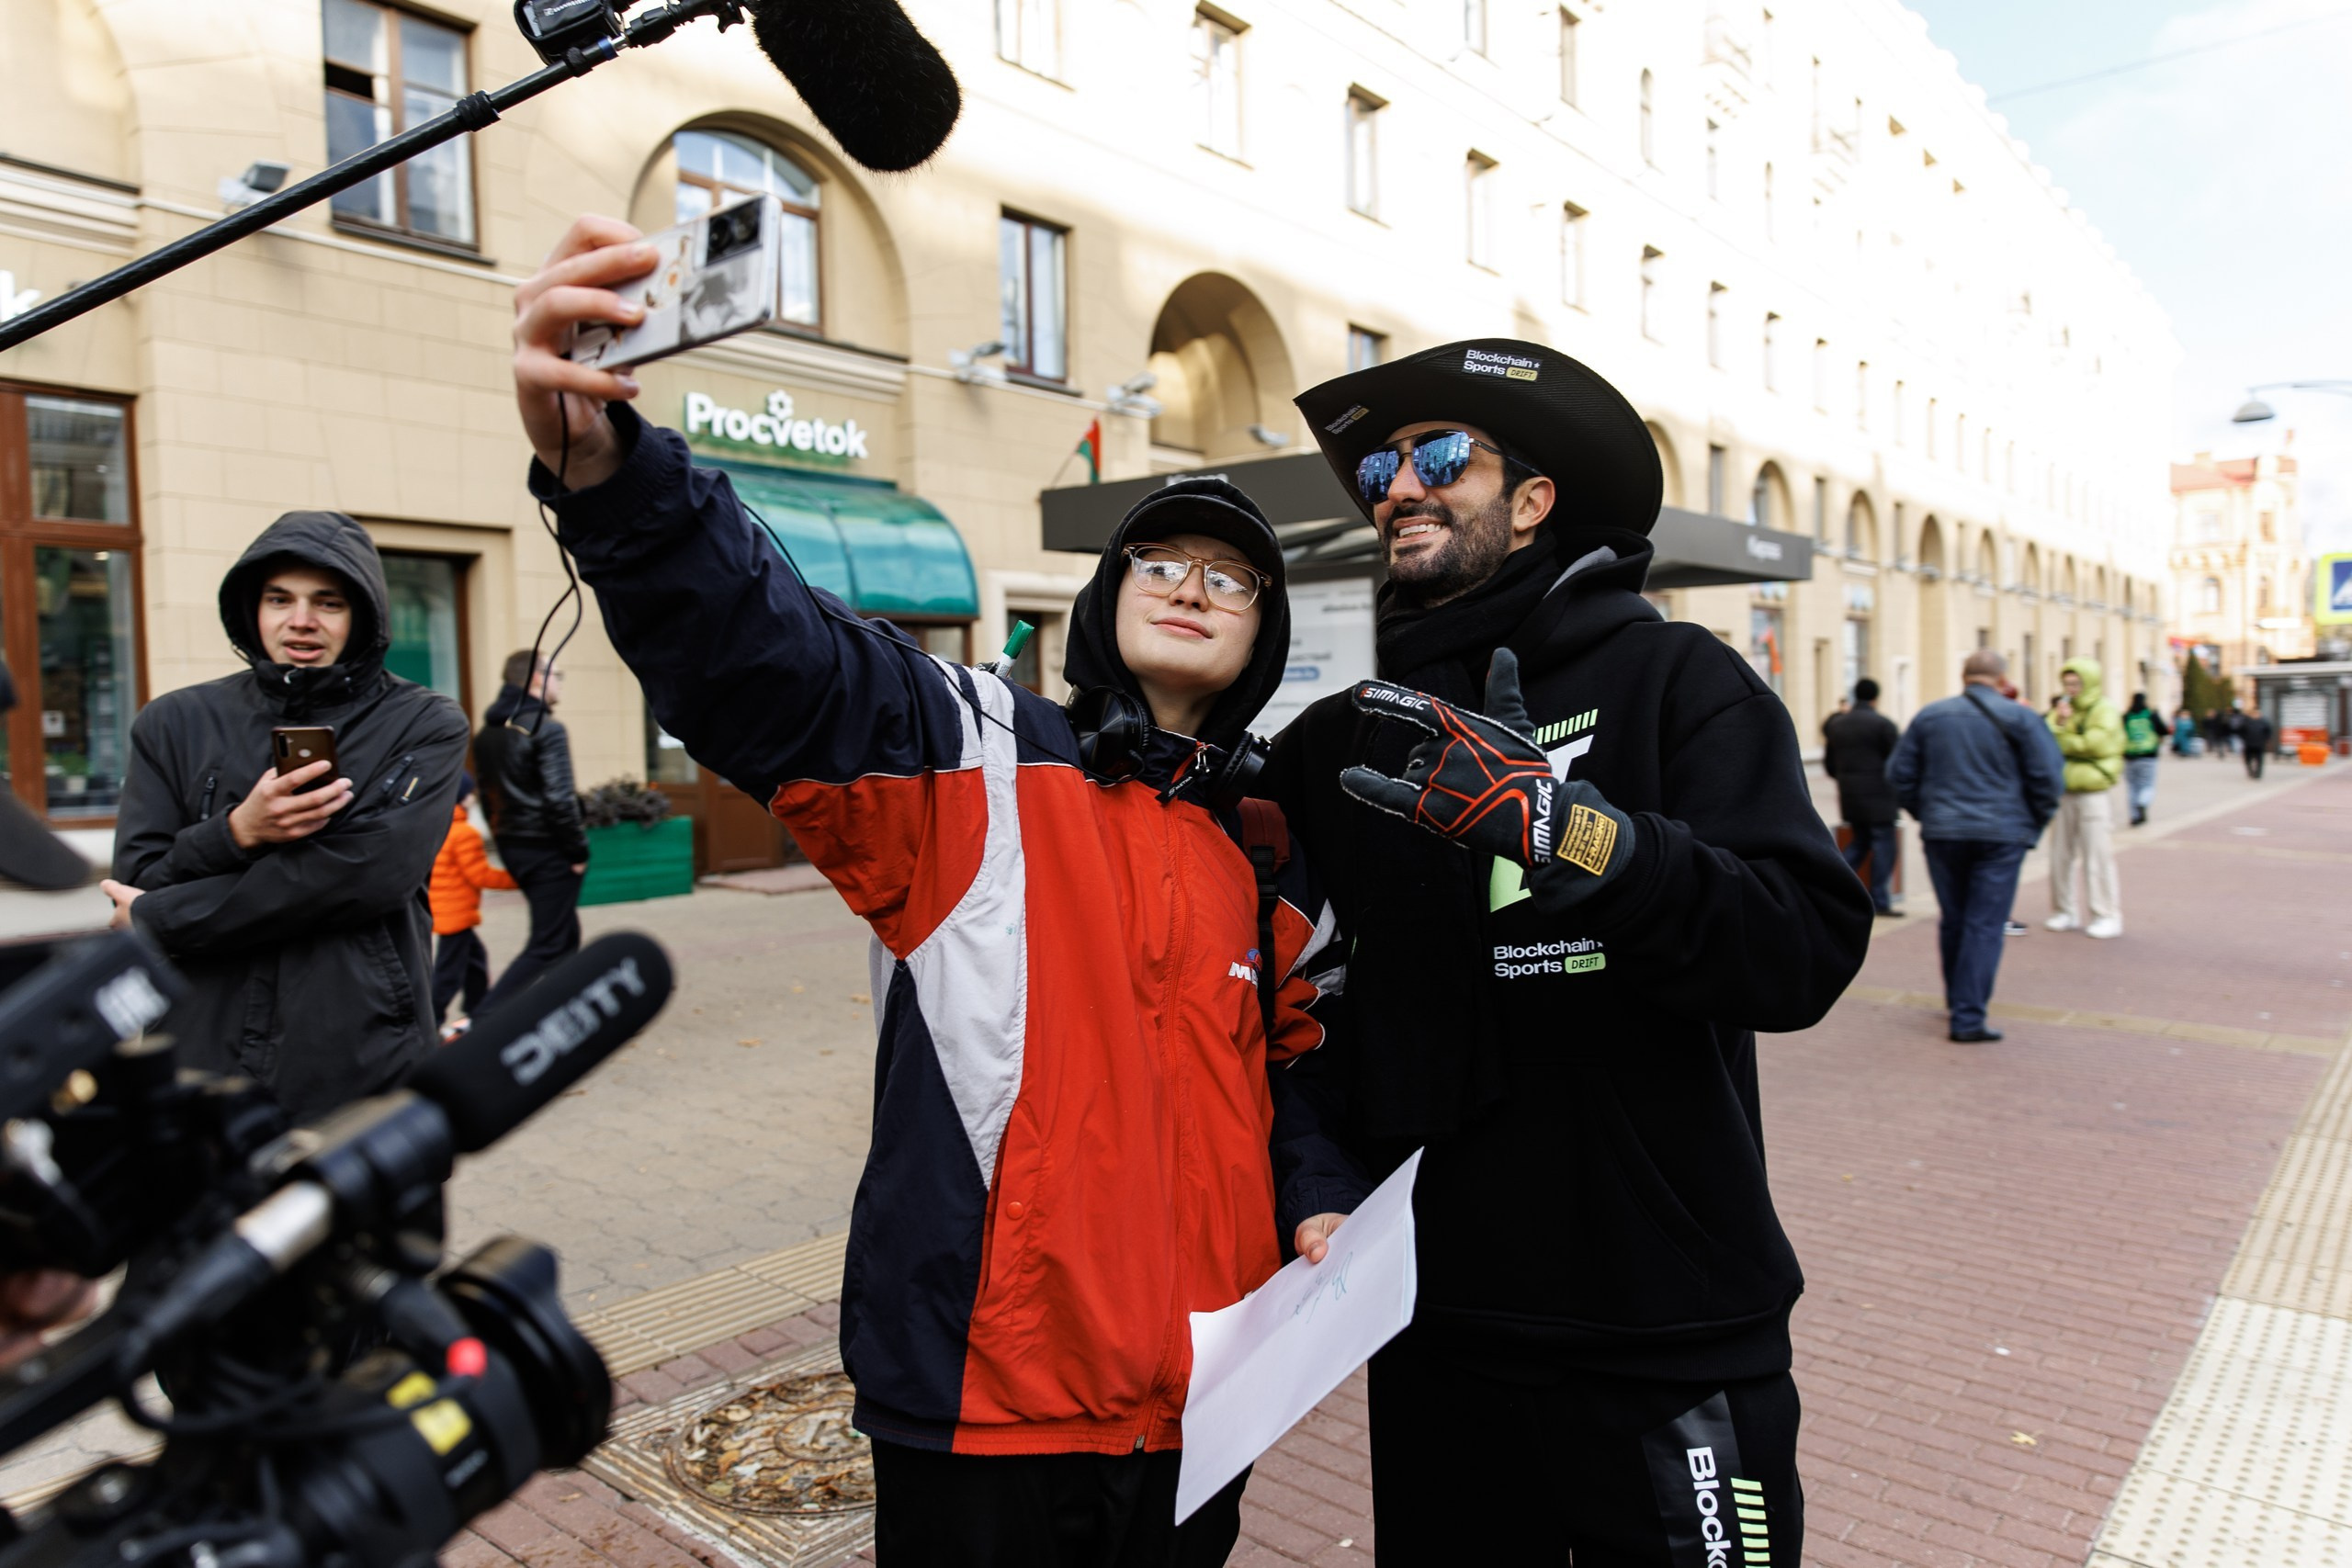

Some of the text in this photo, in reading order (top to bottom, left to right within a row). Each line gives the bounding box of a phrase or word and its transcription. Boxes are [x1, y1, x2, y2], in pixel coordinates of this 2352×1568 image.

[1463, 360, 1534, 378] Sports DRIFT
[1465, 349, 1533, 368] Blockchain
[684, 390, 870, 458] Procvetok
[1362, 687, 1431, 711] SIMAGIC
[1532, 778, 1553, 864] SIMAGIC
[1493, 938, 1595, 960] Blockchain
[1494, 956, 1600, 979] Sports DRIFT
[500, 956, 646, 1087] DEITY
